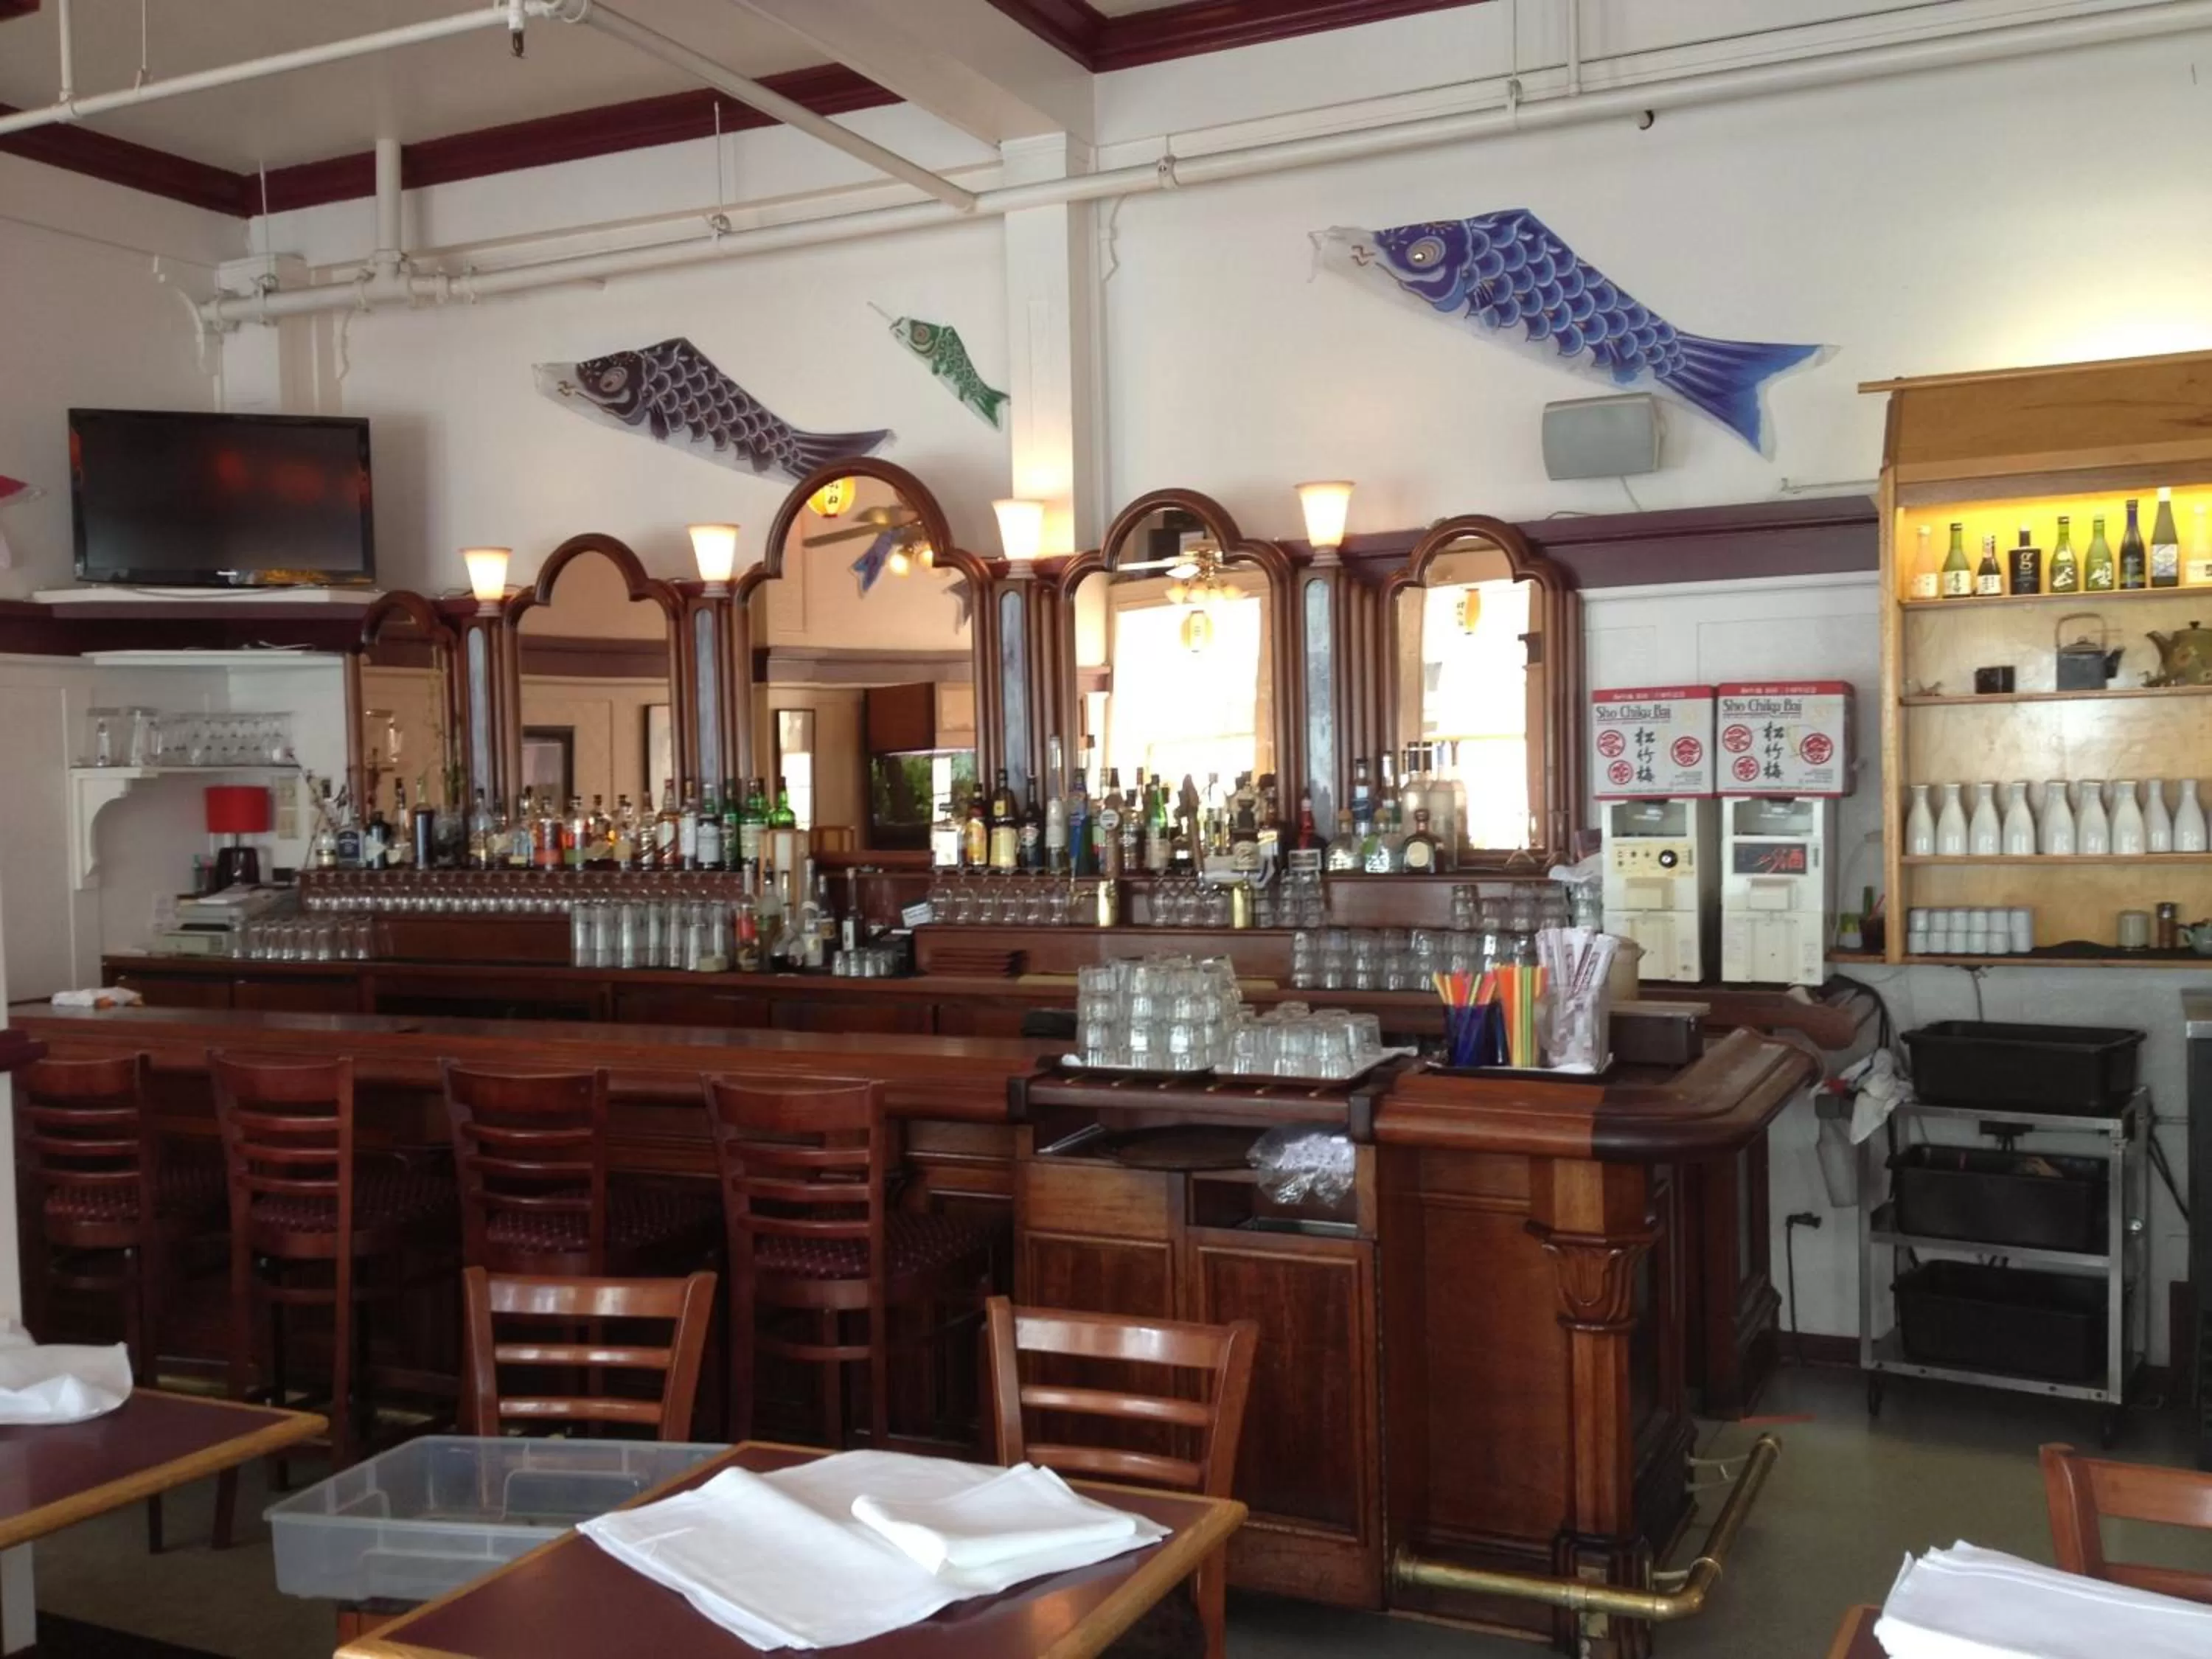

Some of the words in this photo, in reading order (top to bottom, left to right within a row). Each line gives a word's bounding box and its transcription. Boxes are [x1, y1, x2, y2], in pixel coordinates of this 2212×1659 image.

[1596, 706, 1617, 719] Sho
[1654, 703, 1671, 718] Bai
[1722, 698, 1746, 712] Sho
[1784, 698, 1802, 712] Bai
